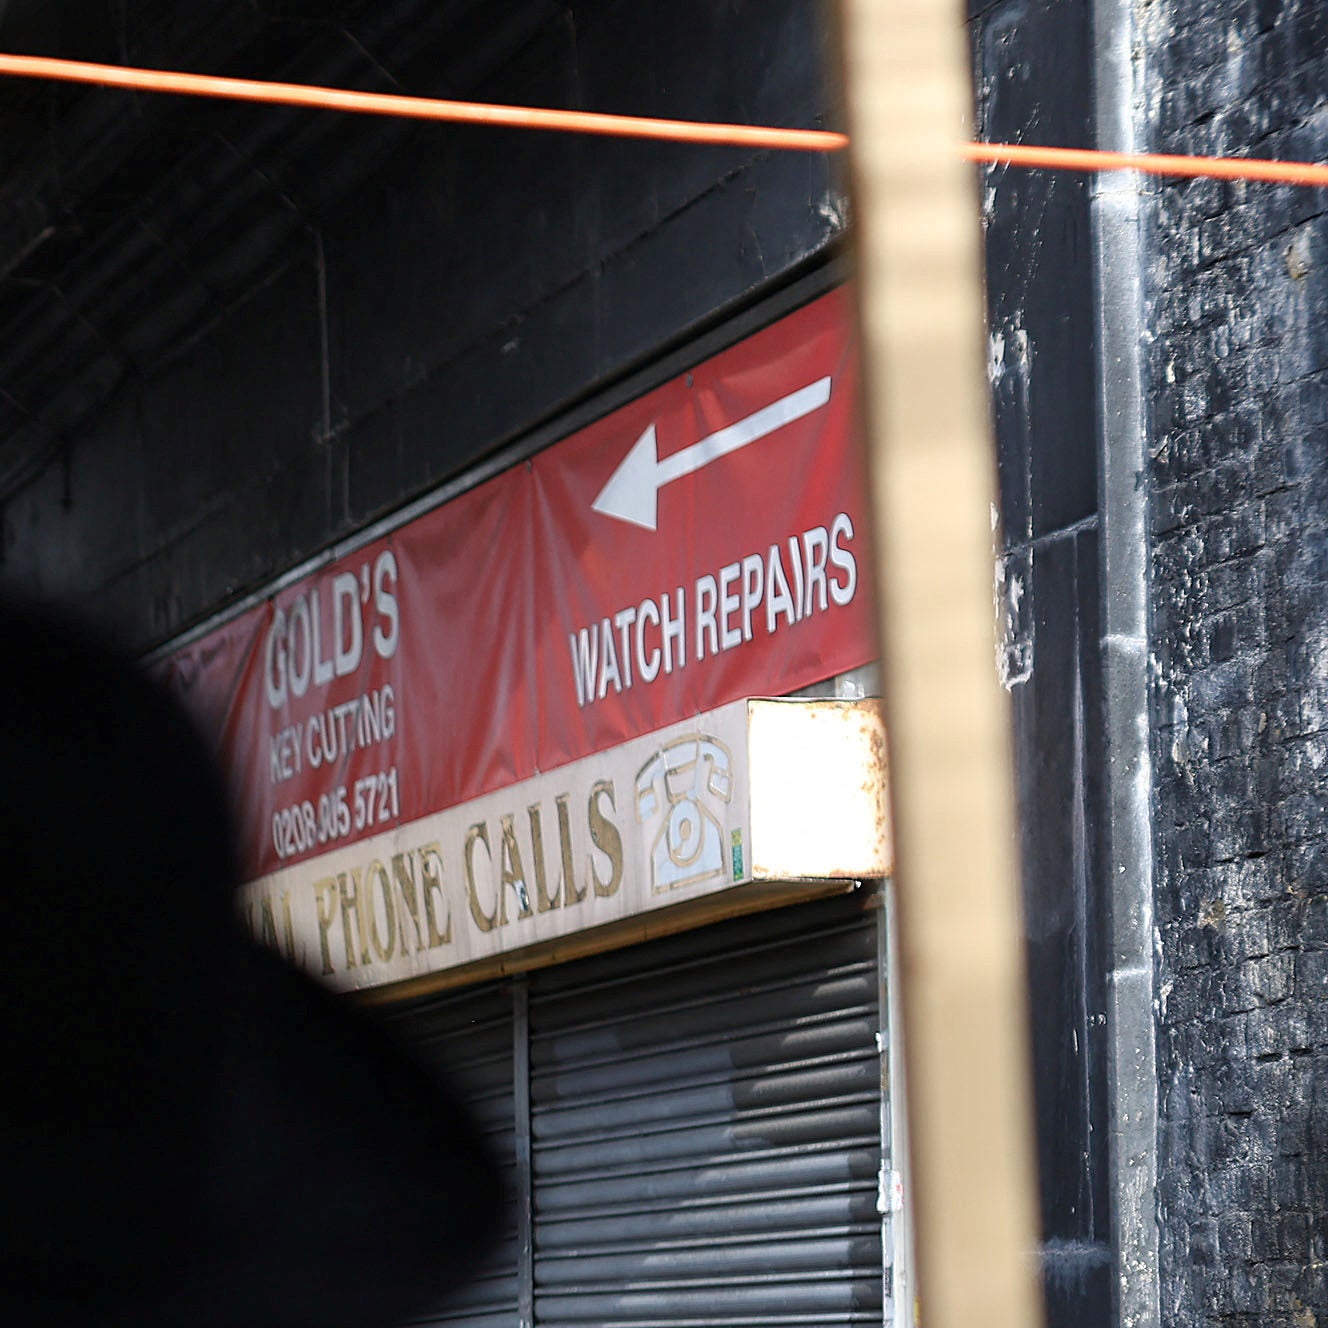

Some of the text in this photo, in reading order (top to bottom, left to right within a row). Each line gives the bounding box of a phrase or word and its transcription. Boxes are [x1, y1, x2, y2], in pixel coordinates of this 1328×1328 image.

[264, 549, 400, 710] GOLD'S
[568, 511, 858, 708] WATCH REPAIRS
[270, 684, 395, 784] KEY CUTTING
[354, 766, 400, 831] 5721
[312, 839, 453, 977] PHONE
[463, 778, 625, 933] CALLS
